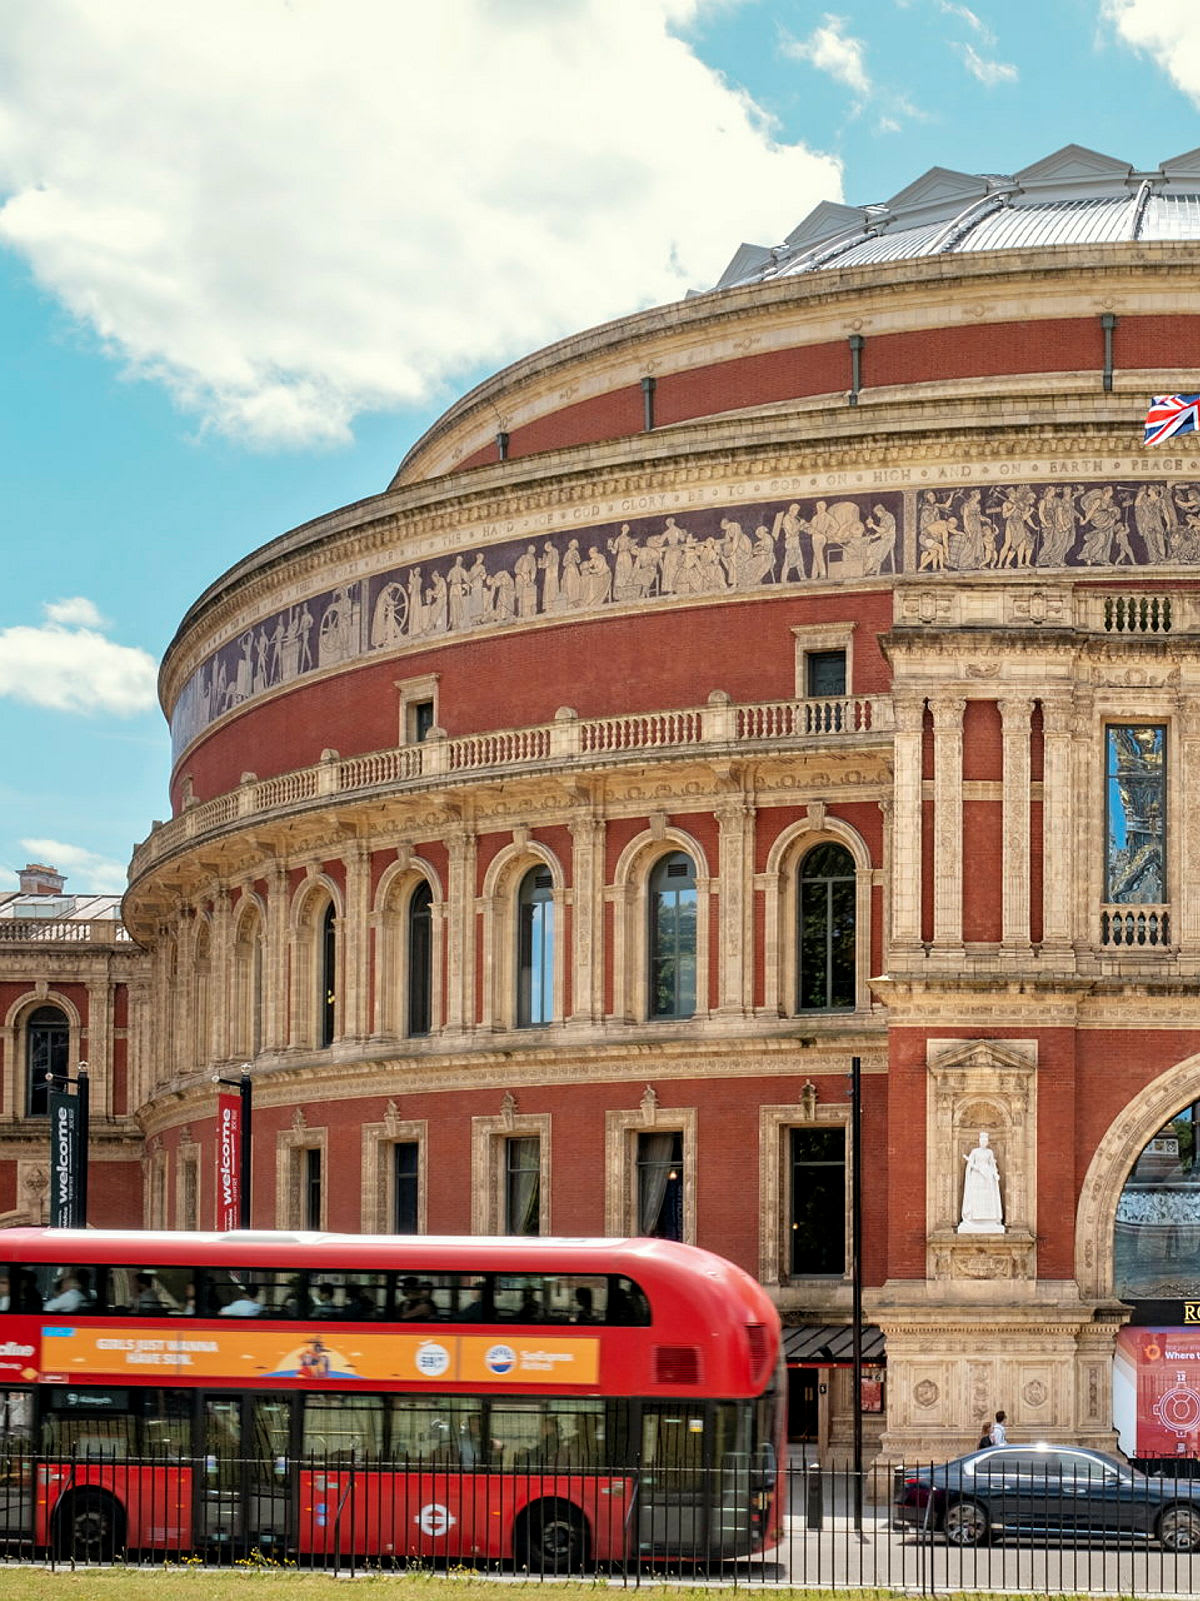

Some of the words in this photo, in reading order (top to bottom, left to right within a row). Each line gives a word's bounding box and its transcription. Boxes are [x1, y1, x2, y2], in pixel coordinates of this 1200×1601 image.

[620, 494, 666, 512] GLORY
[727, 484, 745, 498] TO
[769, 477, 801, 492] GOD
[826, 472, 848, 486] ON
[872, 468, 912, 483] HIGH
[937, 463, 972, 479] AND
[999, 462, 1021, 475] ON
[1048, 459, 1104, 474] EARTH
[1130, 458, 1184, 472] PEACE
[57, 1106, 68, 1204] welcome
[221, 1108, 232, 1205] welcome
[1165, 1351, 1196, 1360] Where
